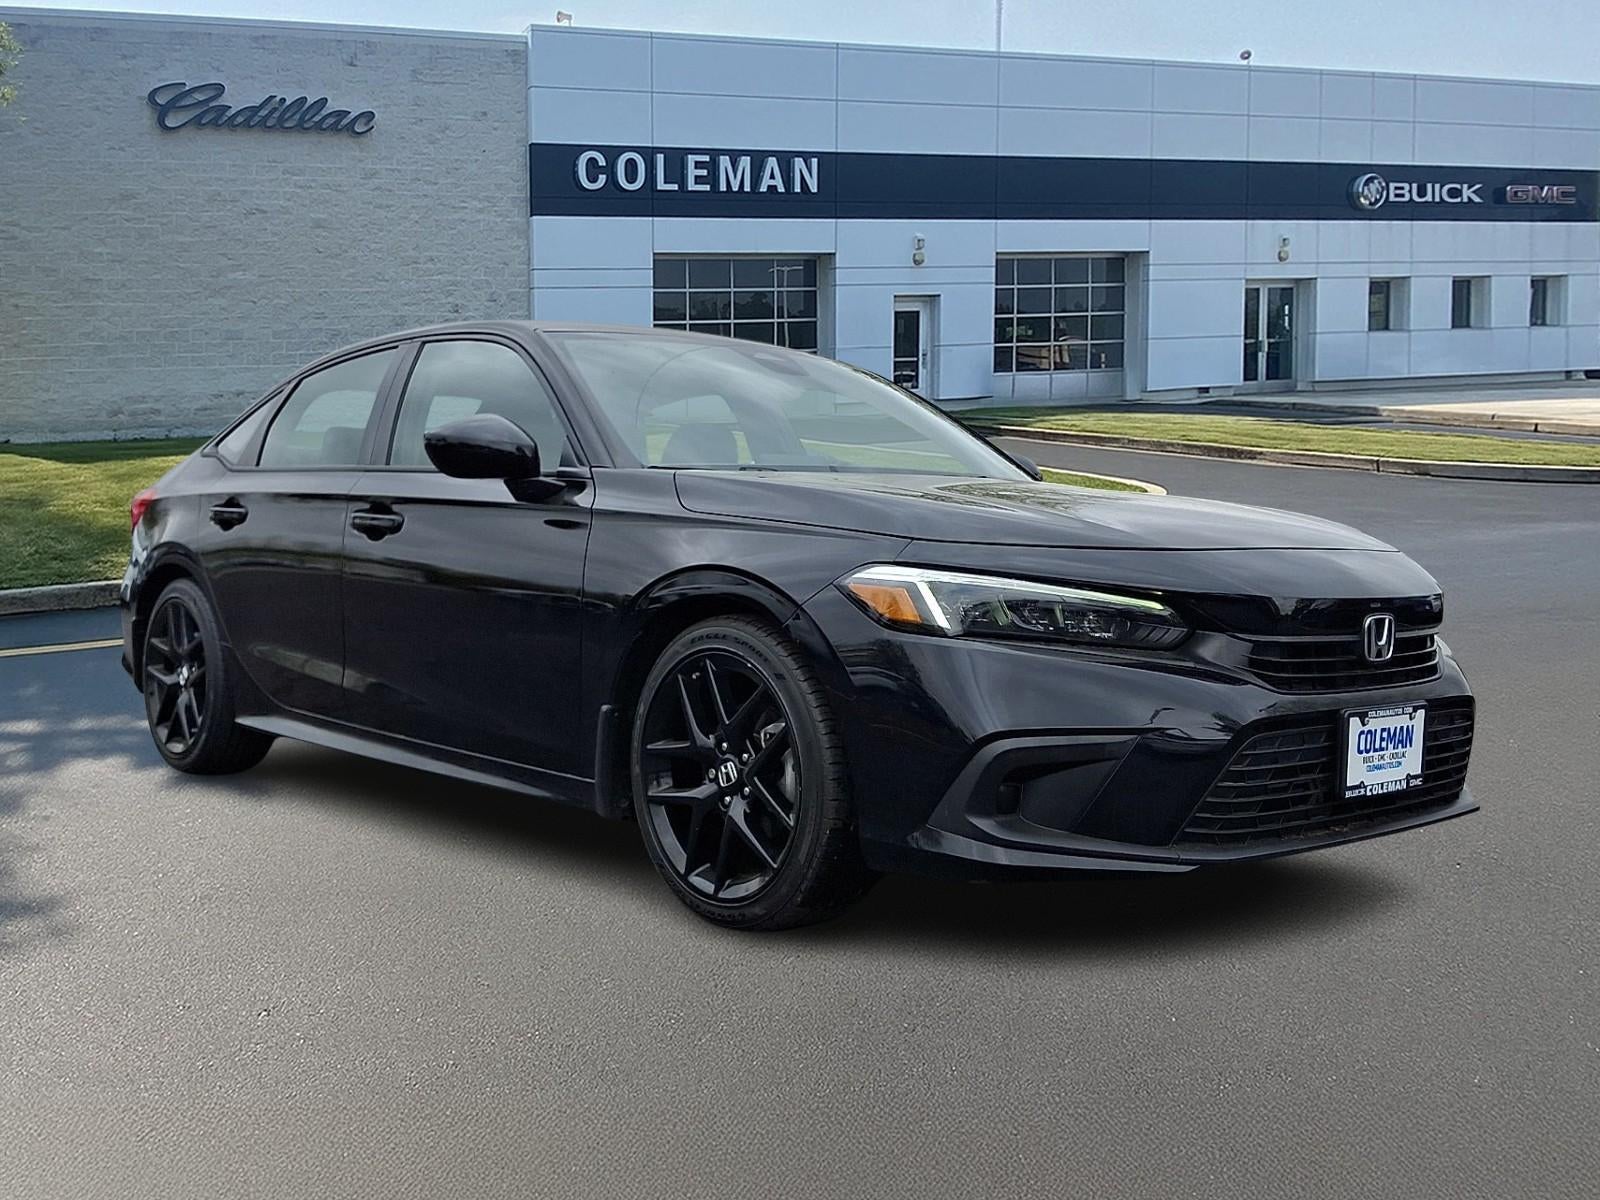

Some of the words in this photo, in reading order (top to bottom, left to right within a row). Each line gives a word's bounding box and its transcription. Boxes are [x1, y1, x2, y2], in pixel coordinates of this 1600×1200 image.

[147, 82, 376, 136] Cadillac
[576, 150, 820, 195] COLEMAN
[1388, 182, 1484, 203] BUICK
[1506, 185, 1577, 204] GMC
[1357, 724, 1415, 755] COLEMAN
[1345, 788, 1366, 798] BUICK
[1366, 779, 1407, 796] COLEMAN
[1409, 778, 1423, 787] GMC
